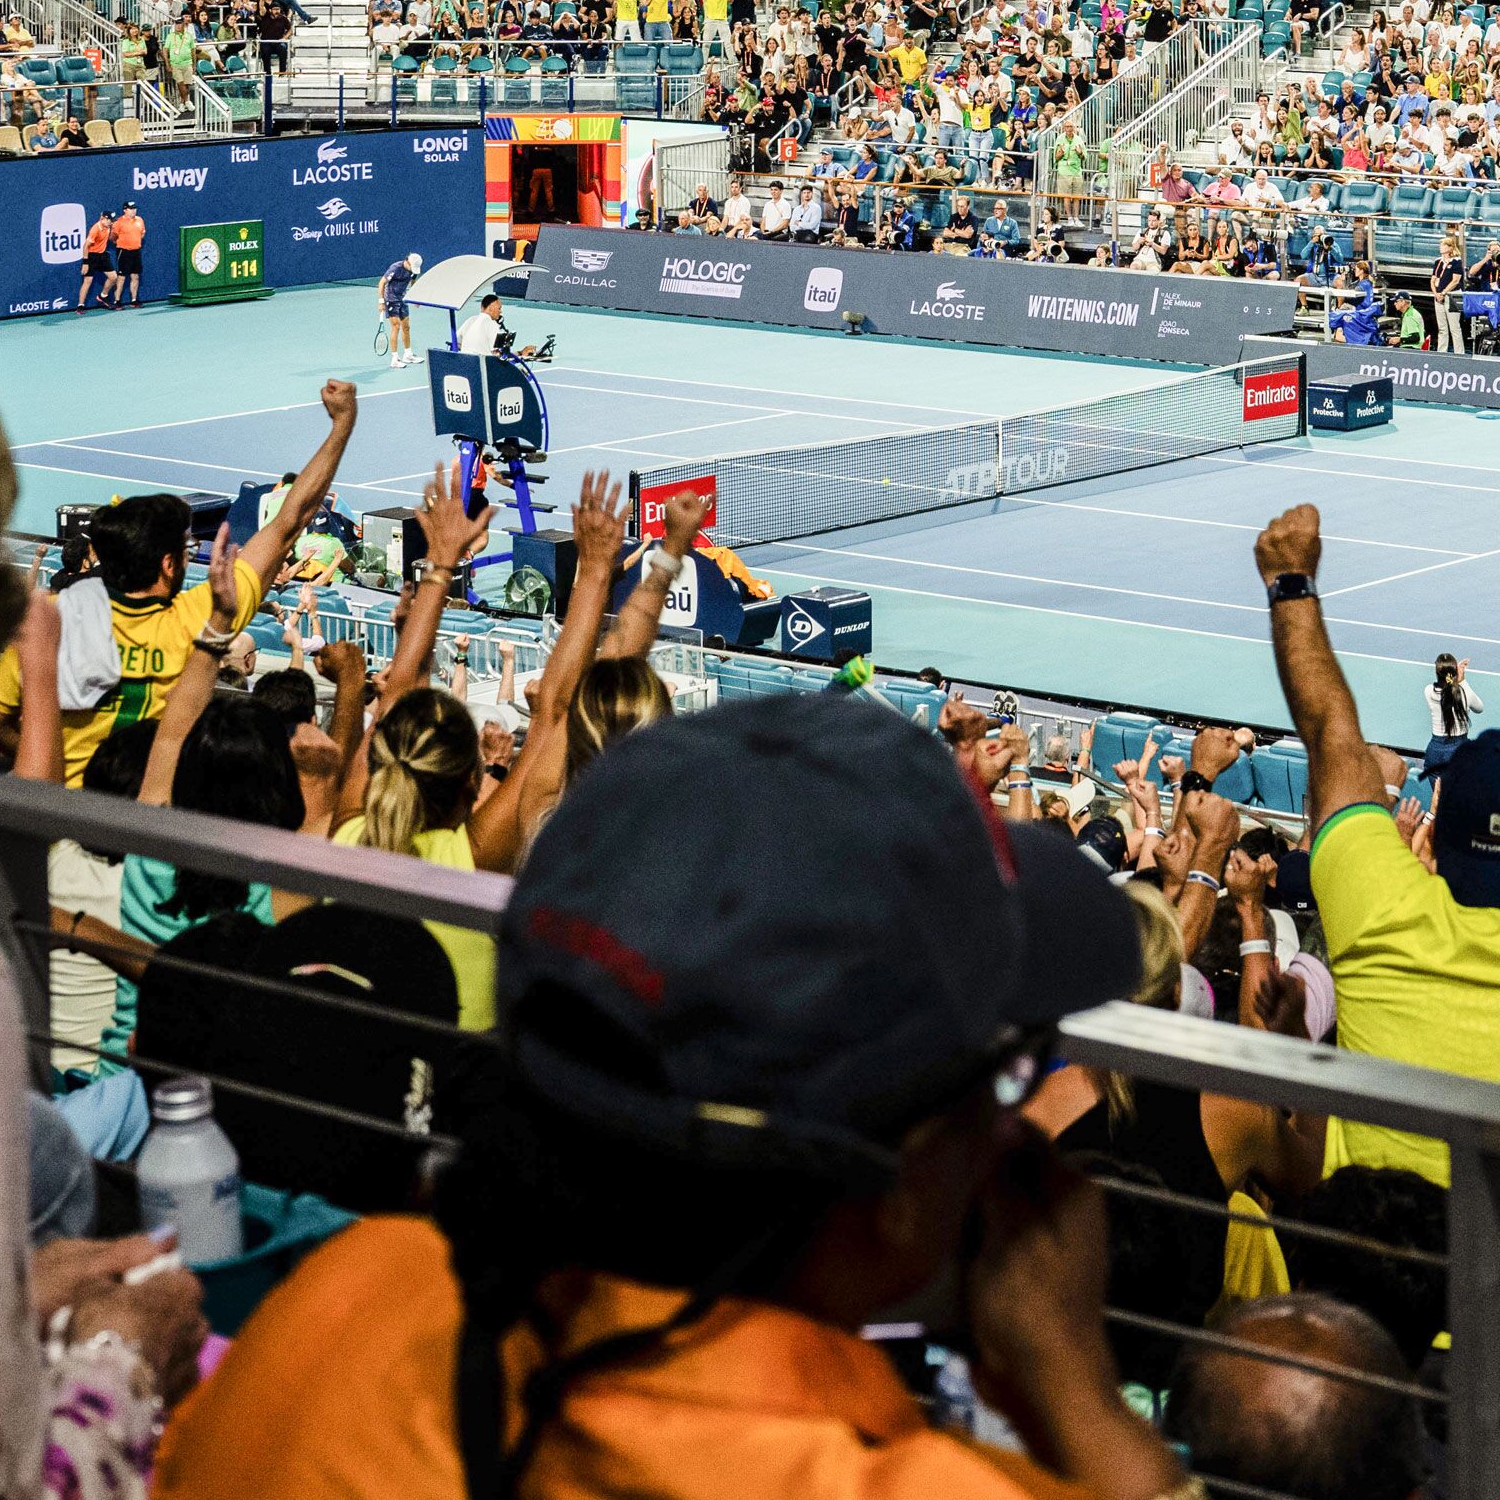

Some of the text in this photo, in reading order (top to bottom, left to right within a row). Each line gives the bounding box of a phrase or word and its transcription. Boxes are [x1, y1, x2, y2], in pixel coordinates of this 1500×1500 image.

[230, 144, 259, 164] itaú
[424, 153, 460, 163] SOLAR
[785, 144, 792, 157] G
[133, 166, 209, 192] betway
[293, 162, 373, 186] LACOSTE
[45, 228, 81, 252] itaú
[291, 219, 379, 243] Disney CRUISE LINE
[229, 239, 259, 251] ROLEX
[229, 259, 258, 278] 1:14
[554, 274, 618, 289] CADILLAC
[807, 284, 838, 304] itaú
[9, 300, 50, 315] LACOSTE
[909, 299, 986, 321] LACOSTE
[1027, 294, 1140, 327] WTATENNIS.COM
[1174, 300, 1202, 309] MINAUR
[1158, 326, 1190, 336] FONSECA
[446, 388, 470, 405] itaú
[1246, 384, 1297, 408] Emirates
[498, 399, 522, 417] itaú
[1312, 407, 1345, 418] Protective
[1356, 404, 1385, 418] Protective
[1001, 448, 1070, 489] TOUR
[833, 621, 871, 636] DUNLOP
